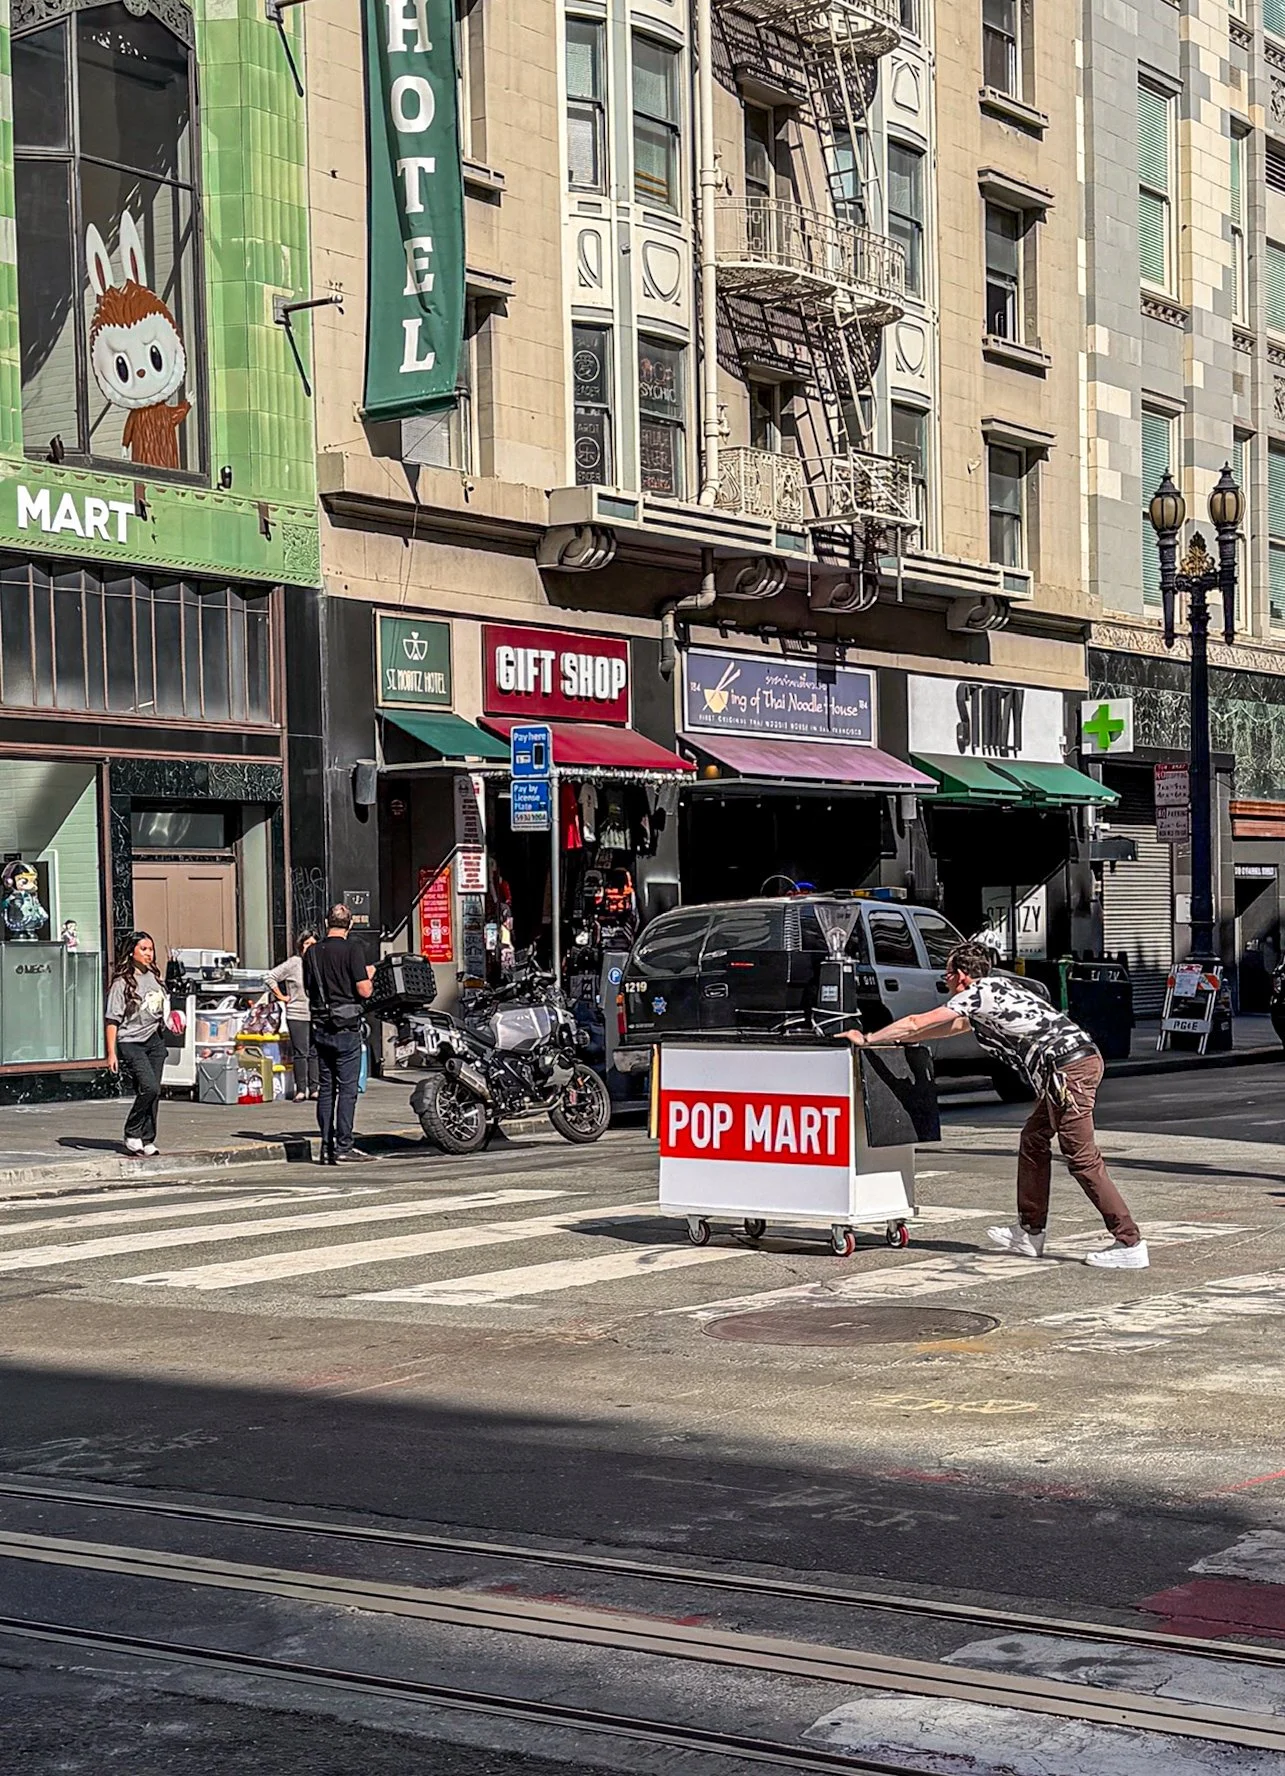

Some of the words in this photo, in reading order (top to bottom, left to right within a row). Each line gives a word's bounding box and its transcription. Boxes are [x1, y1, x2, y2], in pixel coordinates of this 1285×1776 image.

[387, 0, 436, 373] HOTEL
[640, 382, 676, 402] SYCHIC
[17, 485, 135, 545] MART
[397, 669, 424, 693] MORITZ
[424, 671, 447, 694] HOTEL
[495, 645, 556, 694] GIFT
[560, 652, 627, 700] SHOP
[750, 687, 761, 714] of
[762, 690, 786, 710] Thai
[788, 692, 823, 713] Noodle
[823, 697, 859, 717] House
[513, 732, 528, 743] Pay
[528, 732, 547, 740] here
[513, 785, 528, 796] Pay
[528, 784, 538, 795] by
[513, 794, 541, 802] License
[513, 802, 533, 810] Plate
[624, 981, 648, 993] 1219
[668, 1101, 734, 1149] POP
[744, 1104, 841, 1155] MART
